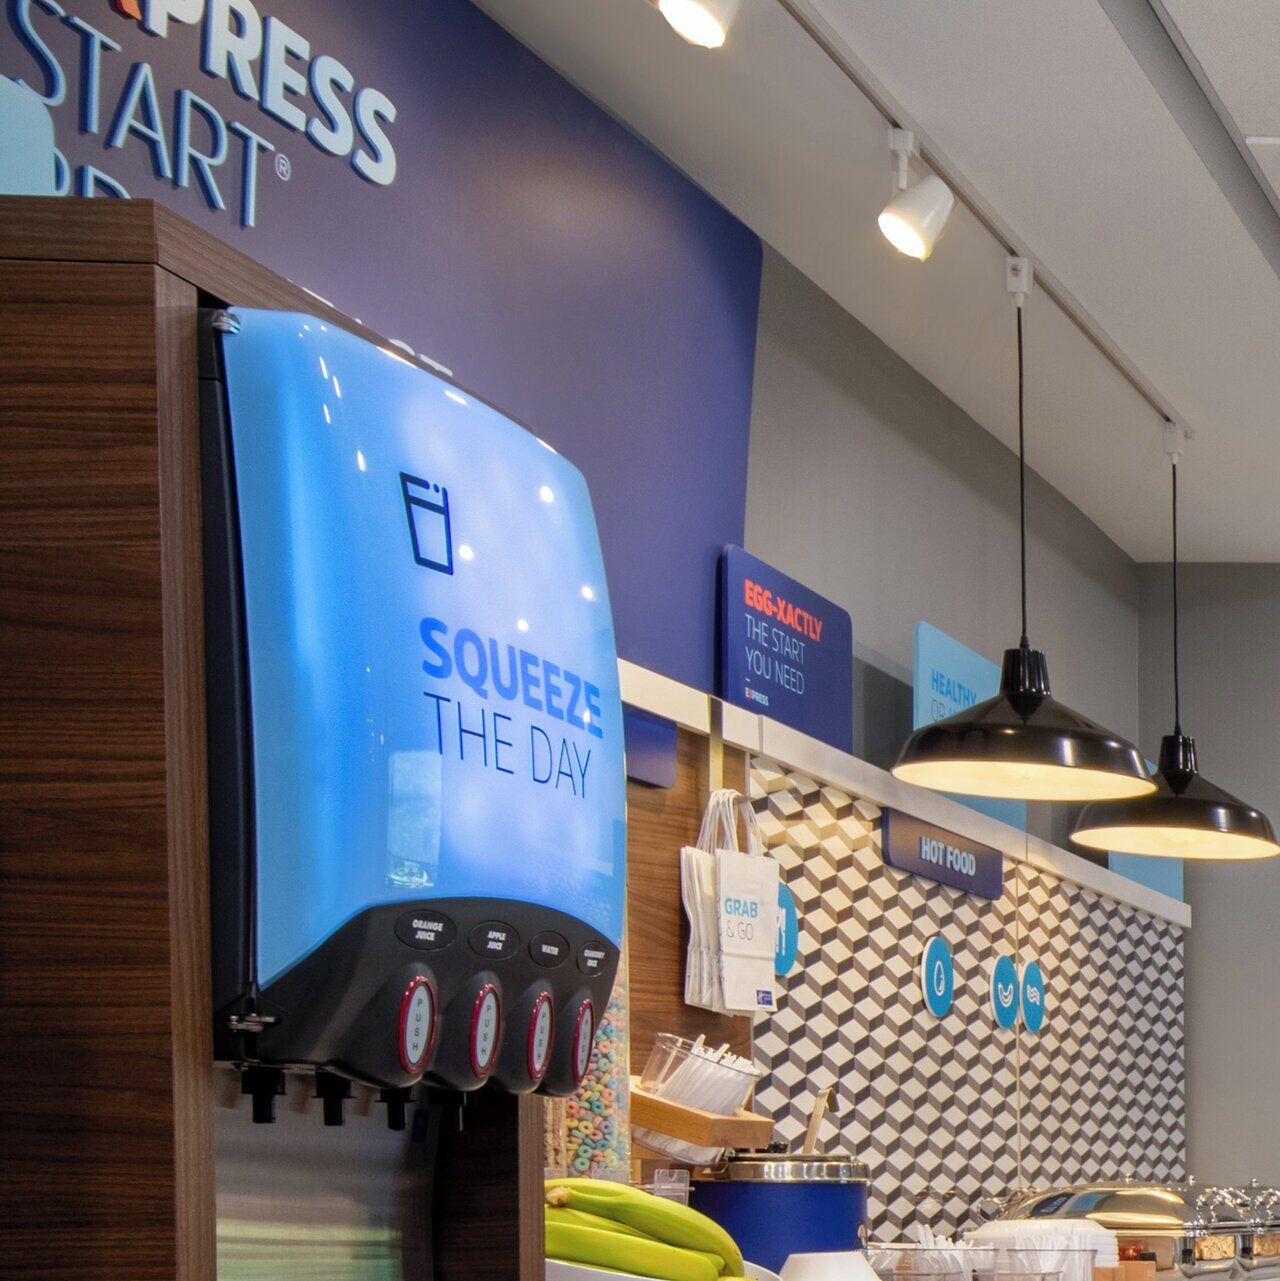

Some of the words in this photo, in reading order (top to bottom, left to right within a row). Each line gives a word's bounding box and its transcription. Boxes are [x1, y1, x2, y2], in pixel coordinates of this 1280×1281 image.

[744, 579, 823, 642] EGG-XACTLY
[744, 613, 769, 648] THE
[771, 627, 805, 665] START
[419, 616, 604, 739] SQUEEZE
[744, 645, 771, 679] YOU
[775, 660, 805, 695] NEED
[931, 668, 977, 708] HEALTHY
[423, 691, 515, 776] THE
[530, 724, 592, 799] DAY
[920, 836, 945, 866] HOT
[945, 845, 976, 877] FOOD
[412, 919, 444, 932] ORANGE
[724, 897, 758, 919] GRAB
[415, 931, 436, 942] JUICE
[486, 940, 503, 950] JUICE
[487, 930, 506, 941] APPLE
[541, 944, 559, 956] WATER
[737, 921, 754, 941] GO
[412, 998, 423, 1051] PUSH
[480, 1005, 492, 1055] PUSH
